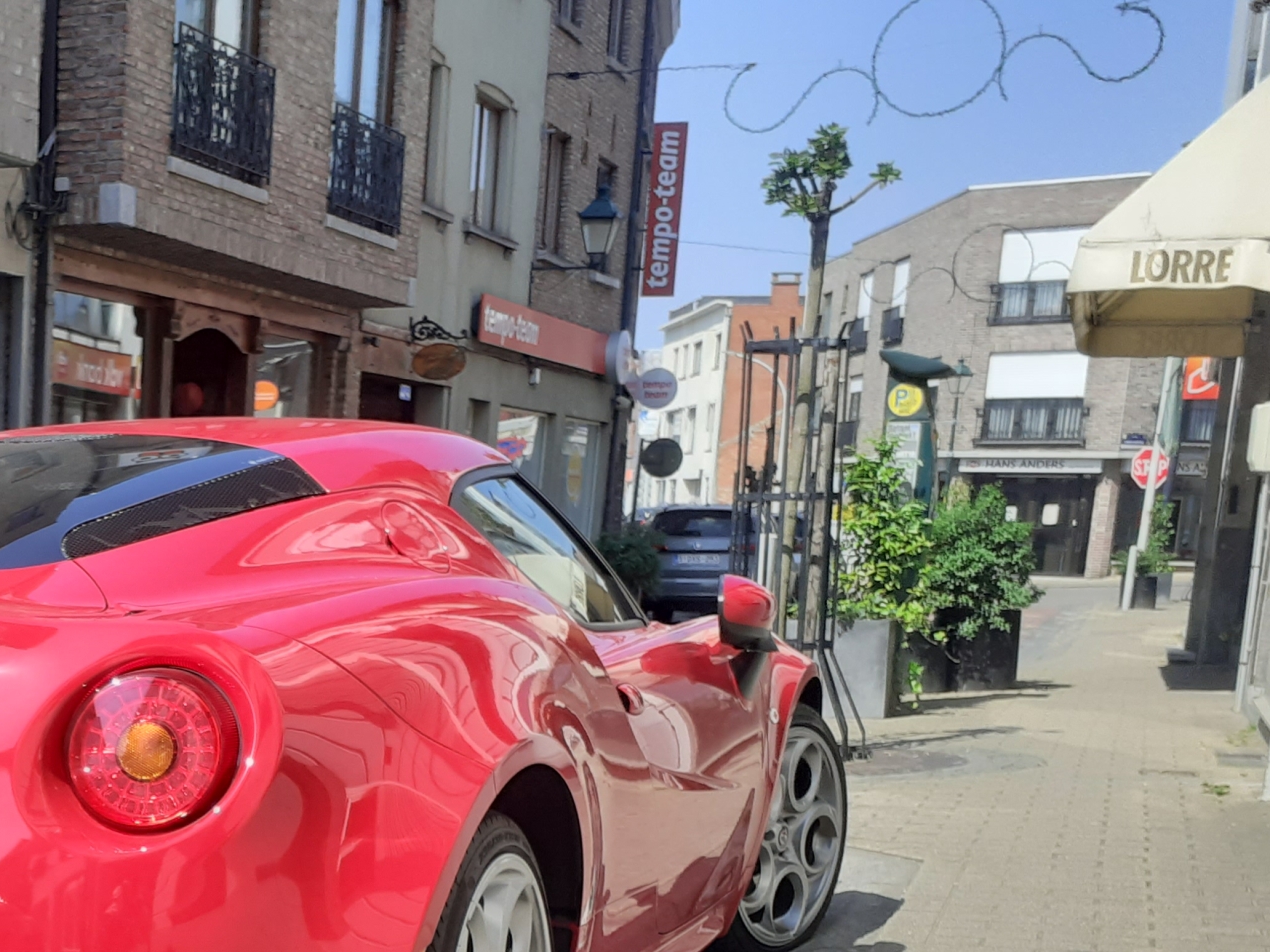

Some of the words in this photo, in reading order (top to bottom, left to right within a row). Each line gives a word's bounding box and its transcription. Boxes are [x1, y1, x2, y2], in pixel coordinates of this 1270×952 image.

[645, 130, 680, 289] tempo-team
[1130, 247, 1234, 284] LORRE
[483, 304, 540, 346] tempo-team
[895, 389, 908, 408] P
[985, 459, 1016, 469] HANS
[1019, 459, 1065, 469] ANDERS
[1133, 458, 1167, 477] STP
